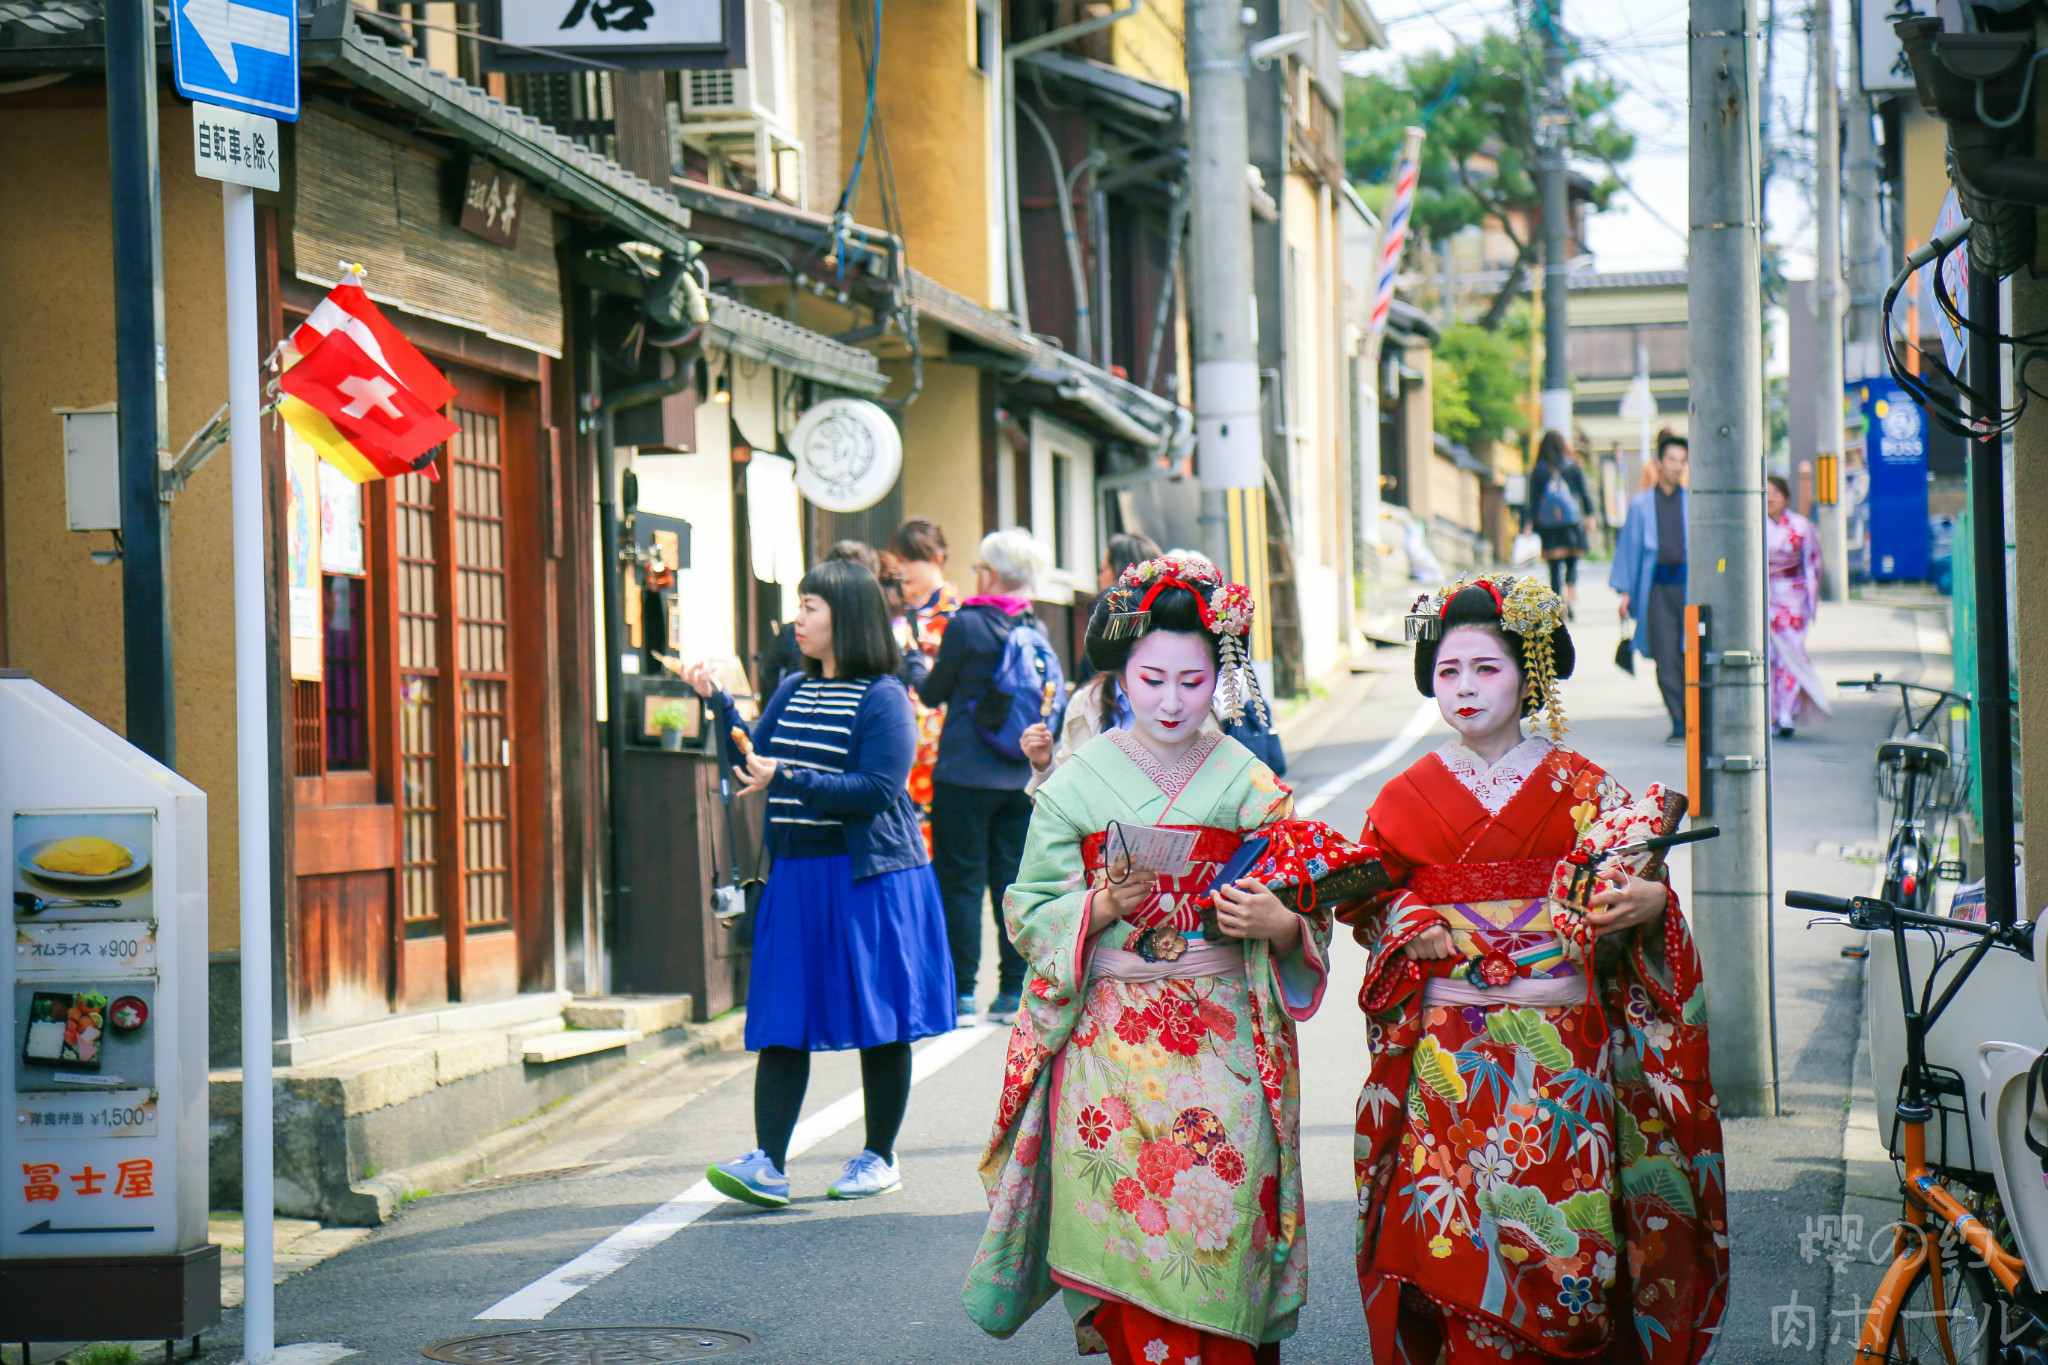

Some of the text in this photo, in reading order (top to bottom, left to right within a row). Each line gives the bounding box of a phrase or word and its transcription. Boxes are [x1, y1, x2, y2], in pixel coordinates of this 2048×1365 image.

[199, 120, 276, 173] 自転車を除く
[1880, 437, 1923, 456] BOSS
[31, 939, 138, 957] オムライス ¥900
[30, 1107, 145, 1128] 洋食弁当 ¥1,500
